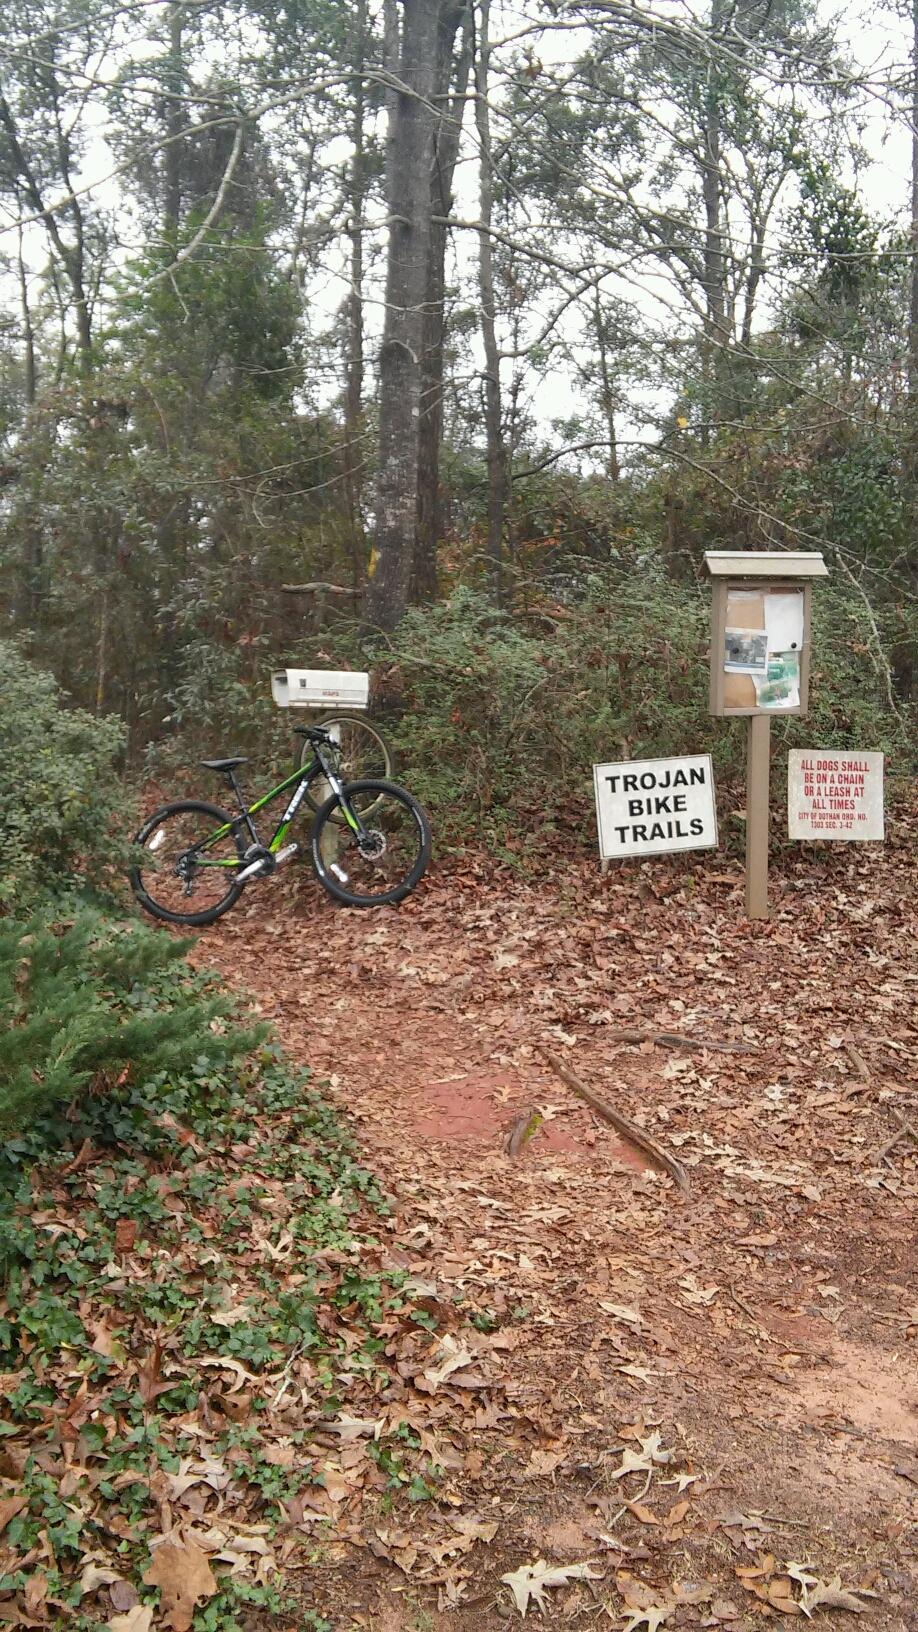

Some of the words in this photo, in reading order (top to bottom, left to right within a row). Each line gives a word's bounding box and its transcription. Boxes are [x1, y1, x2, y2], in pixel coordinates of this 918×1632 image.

[801, 759, 814, 770] ALL
[817, 760, 839, 771] DOGS
[841, 761, 869, 772] SHALL
[605, 767, 705, 793] TROJAN
[804, 773, 813, 783] BE
[816, 773, 827, 784] ON
[830, 774, 835, 784] A
[837, 774, 864, 785] CHAIN
[804, 786, 814, 796] OR
[816, 786, 821, 797] A
[824, 786, 851, 797] LEASH
[853, 787, 865, 798] AT
[628, 794, 688, 817] BIKE
[812, 799, 826, 809] ALL
[829, 799, 856, 810] TIMES
[798, 811, 809, 820] CITY
[614, 818, 704, 843] TRAILS
